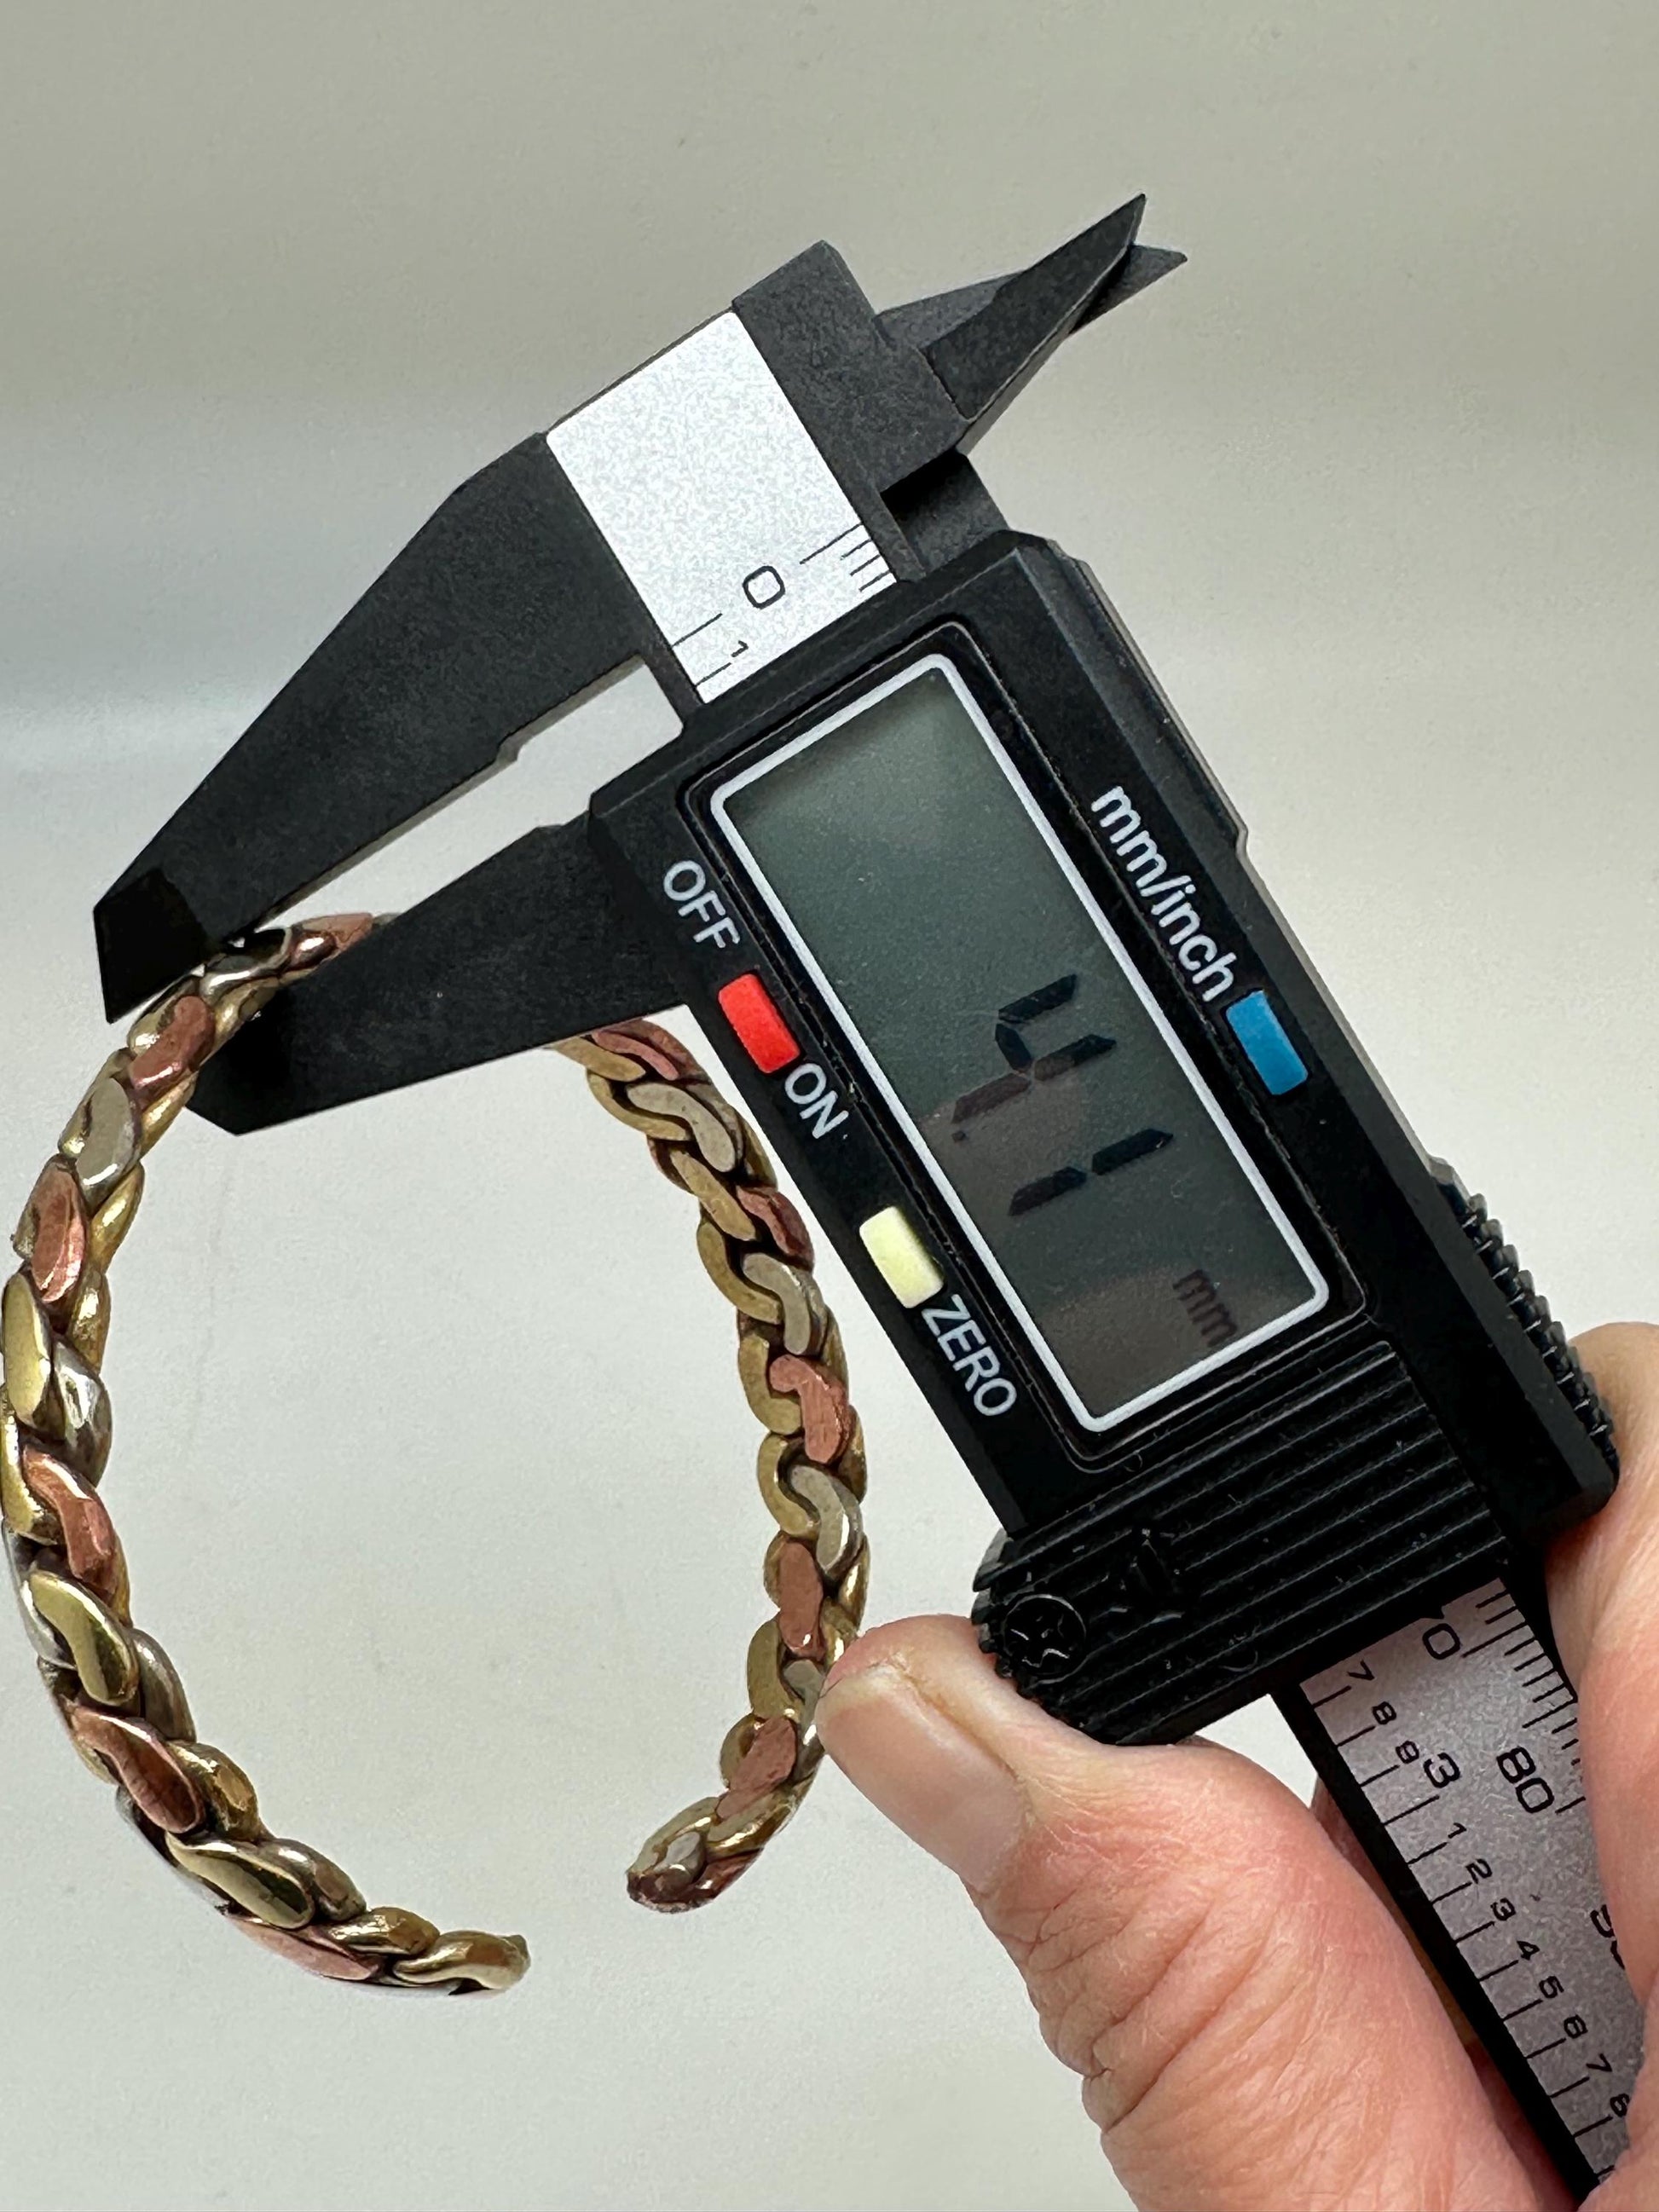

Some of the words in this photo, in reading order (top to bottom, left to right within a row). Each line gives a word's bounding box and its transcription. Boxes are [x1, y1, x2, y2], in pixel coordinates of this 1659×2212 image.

[742, 565, 786, 610] 0
[662, 859, 741, 950] OFF
[1090, 785, 1238, 1003] mm/inch
[784, 1062, 850, 1141] ON
[1172, 1268, 1239, 1349] mm
[921, 1293, 1018, 1418] ZERO
[1422, 1623, 1460, 1660] 0
[1348, 1660, 1375, 1682] 7
[1372, 1701, 1397, 1725] 8
[1423, 1752, 1460, 1788] 3
[1496, 1746, 1555, 1814] 80
[1465, 1858, 1493, 1884] 2
[1490, 1897, 1517, 1922] 3
[1517, 1940, 1540, 1961] 4
[1538, 1975, 1564, 1999] 5
[1563, 2014, 1588, 2039] 6
[1586, 2053, 1613, 2073] 7
